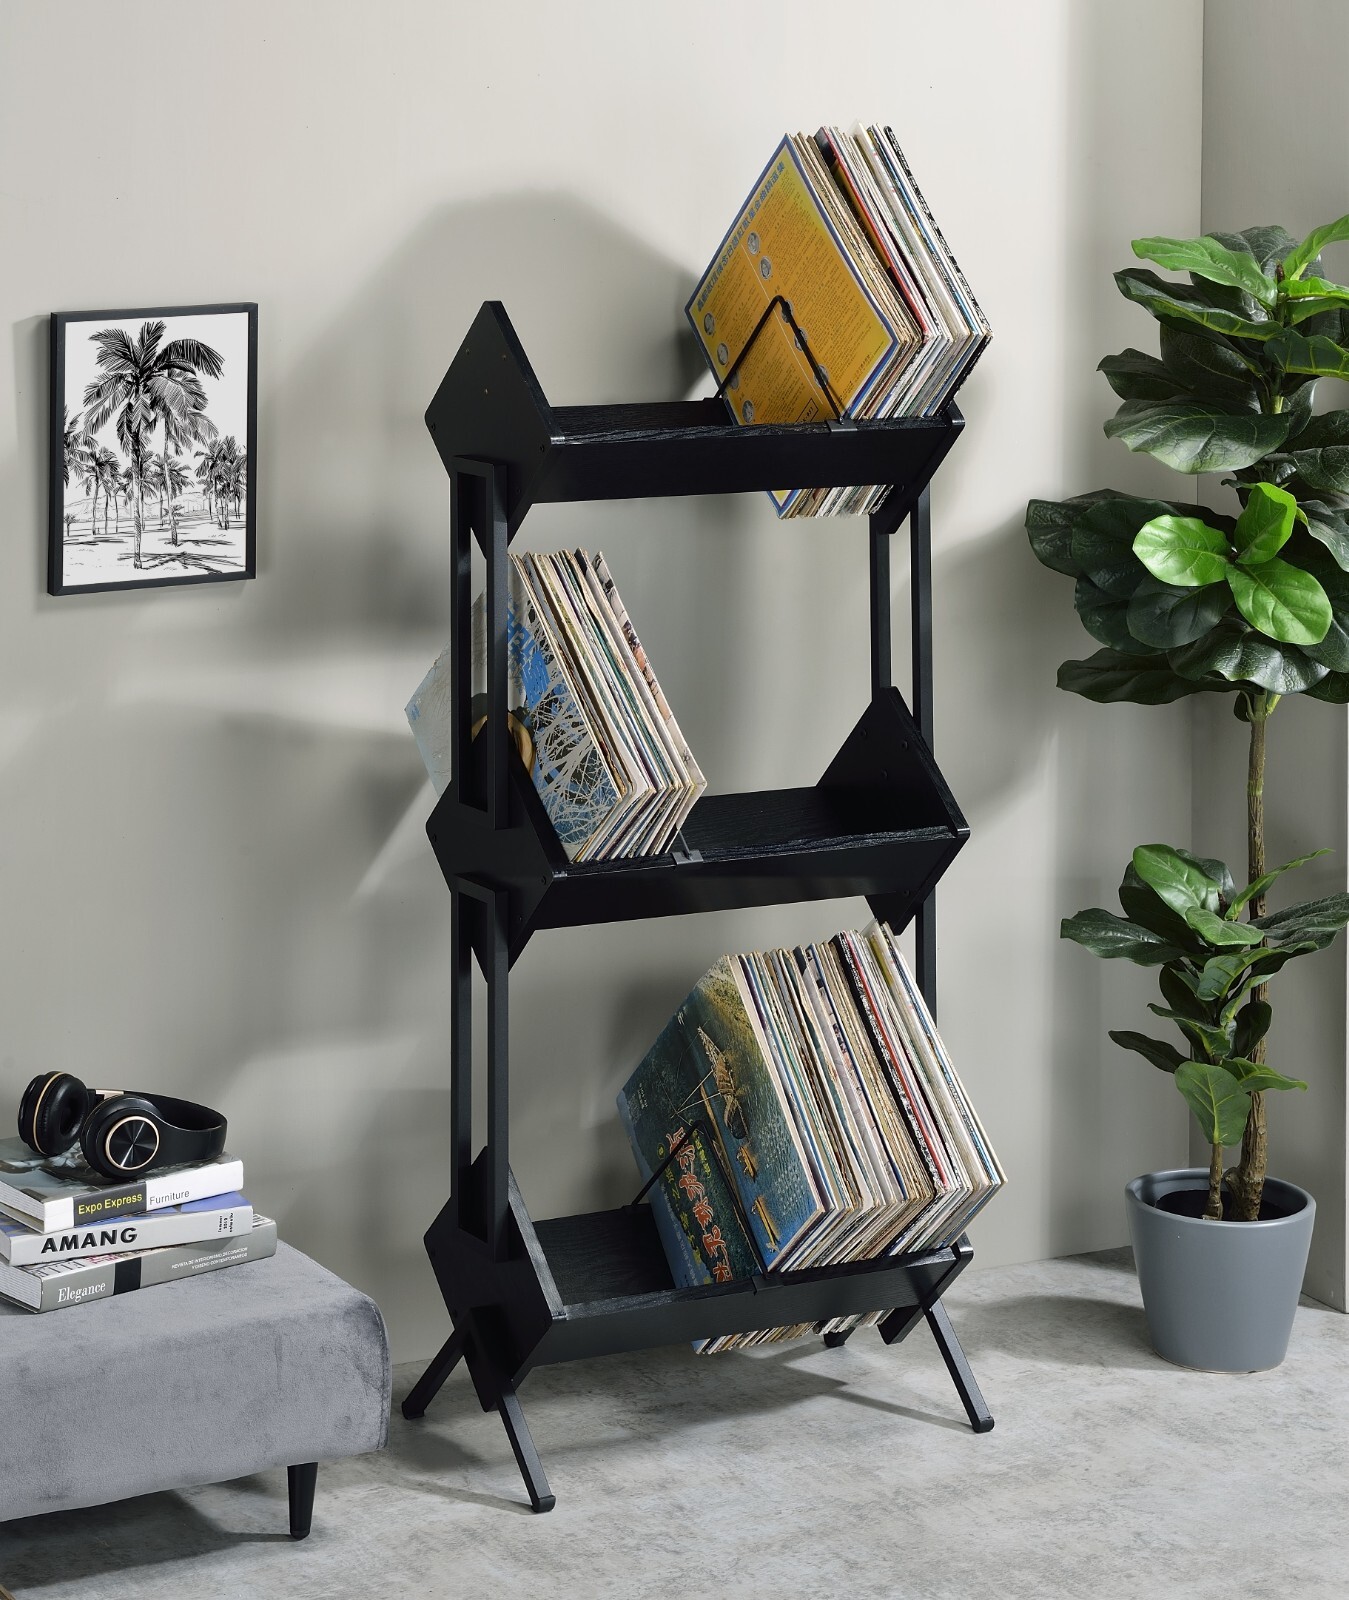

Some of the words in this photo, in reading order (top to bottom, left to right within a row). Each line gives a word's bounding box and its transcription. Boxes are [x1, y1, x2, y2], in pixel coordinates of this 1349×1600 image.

[78, 1202, 102, 1215] Expo
[104, 1193, 143, 1210] Express
[149, 1189, 190, 1206] Furniture
[41, 1227, 138, 1254] AMANG
[57, 1282, 106, 1303] Elegance
